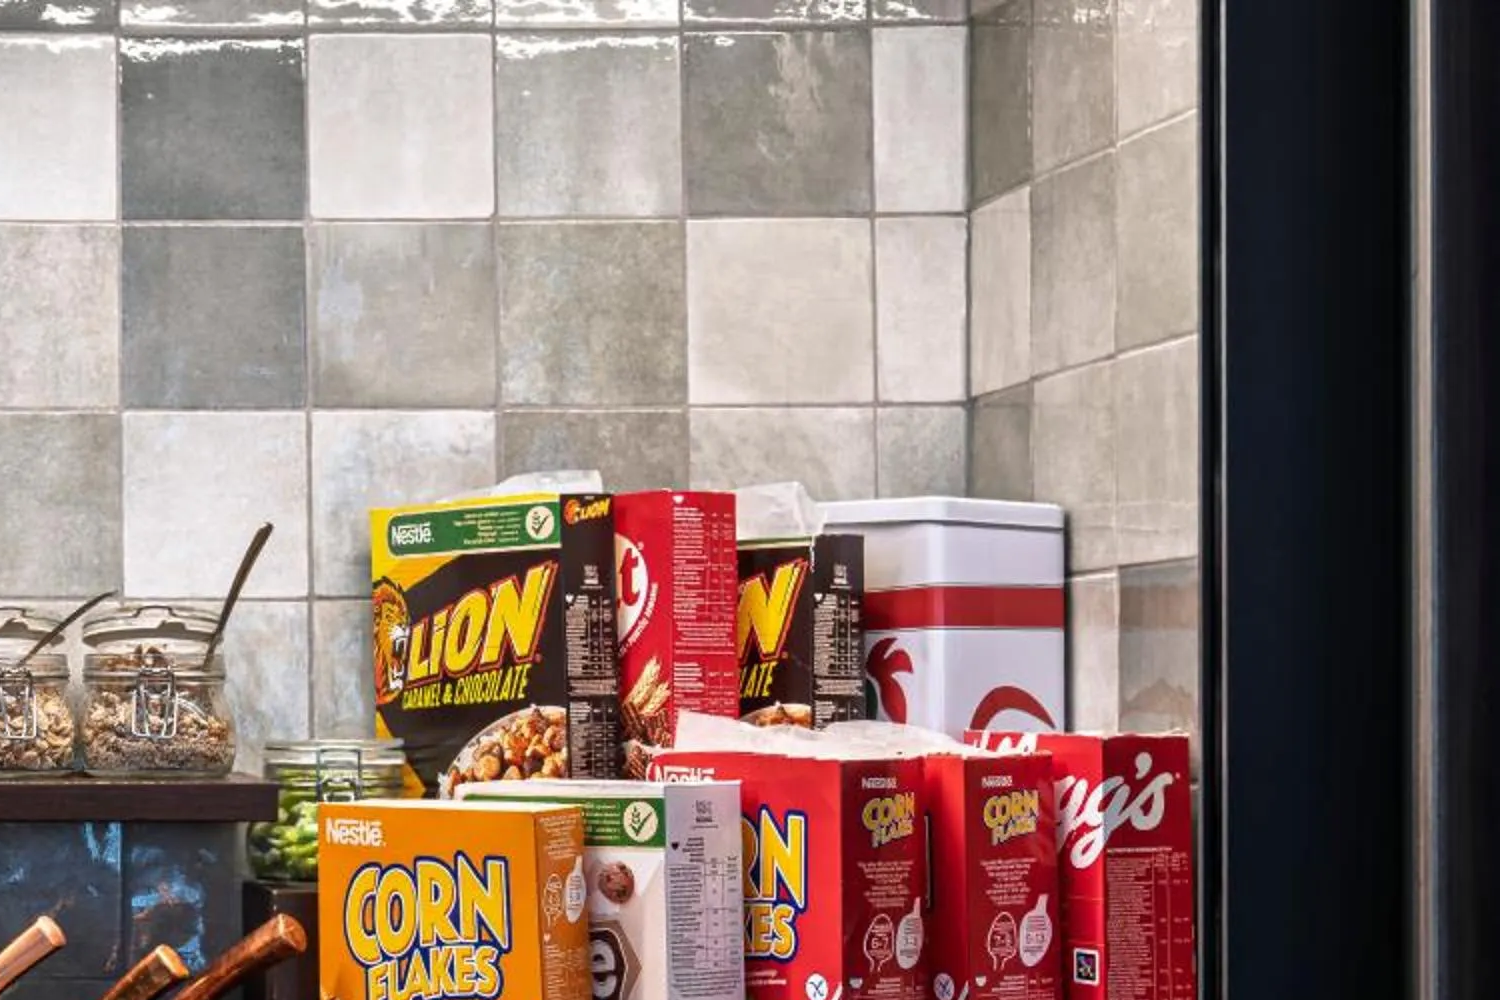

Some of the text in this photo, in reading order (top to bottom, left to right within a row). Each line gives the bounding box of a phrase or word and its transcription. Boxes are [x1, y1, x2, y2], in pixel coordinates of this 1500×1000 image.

[392, 521, 432, 546] Nestlé
[403, 684, 440, 710] CARAMEL
[454, 664, 533, 705] CHOCOLATE
[862, 792, 915, 832] CORN
[984, 789, 1039, 829] CORN
[325, 817, 384, 846] Nestlé
[344, 852, 511, 965] CORN
